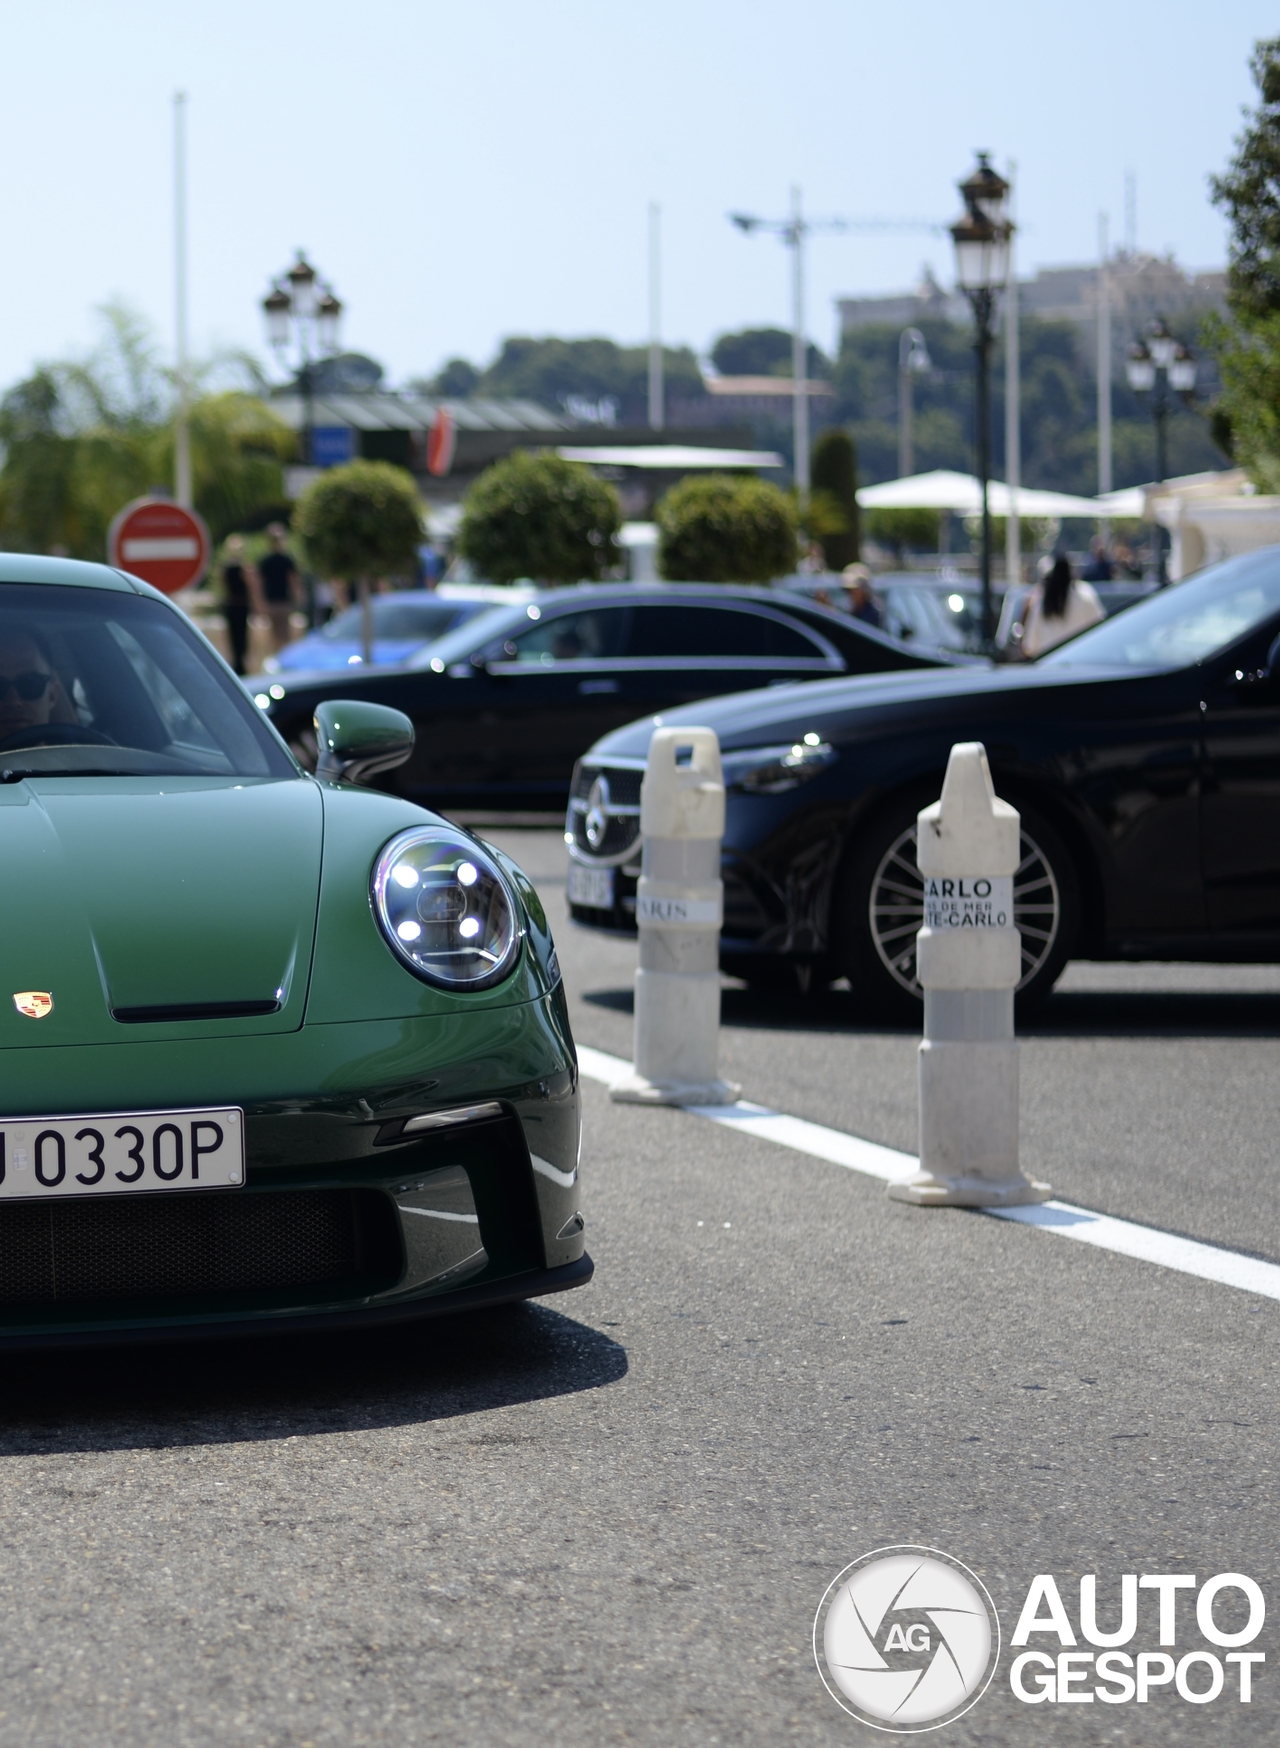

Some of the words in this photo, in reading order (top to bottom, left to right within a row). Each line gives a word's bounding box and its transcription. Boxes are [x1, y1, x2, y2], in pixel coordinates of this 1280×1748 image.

[941, 902, 958, 911] DE
[964, 902, 992, 912] MER
[34, 1120, 224, 1187] 0330P
